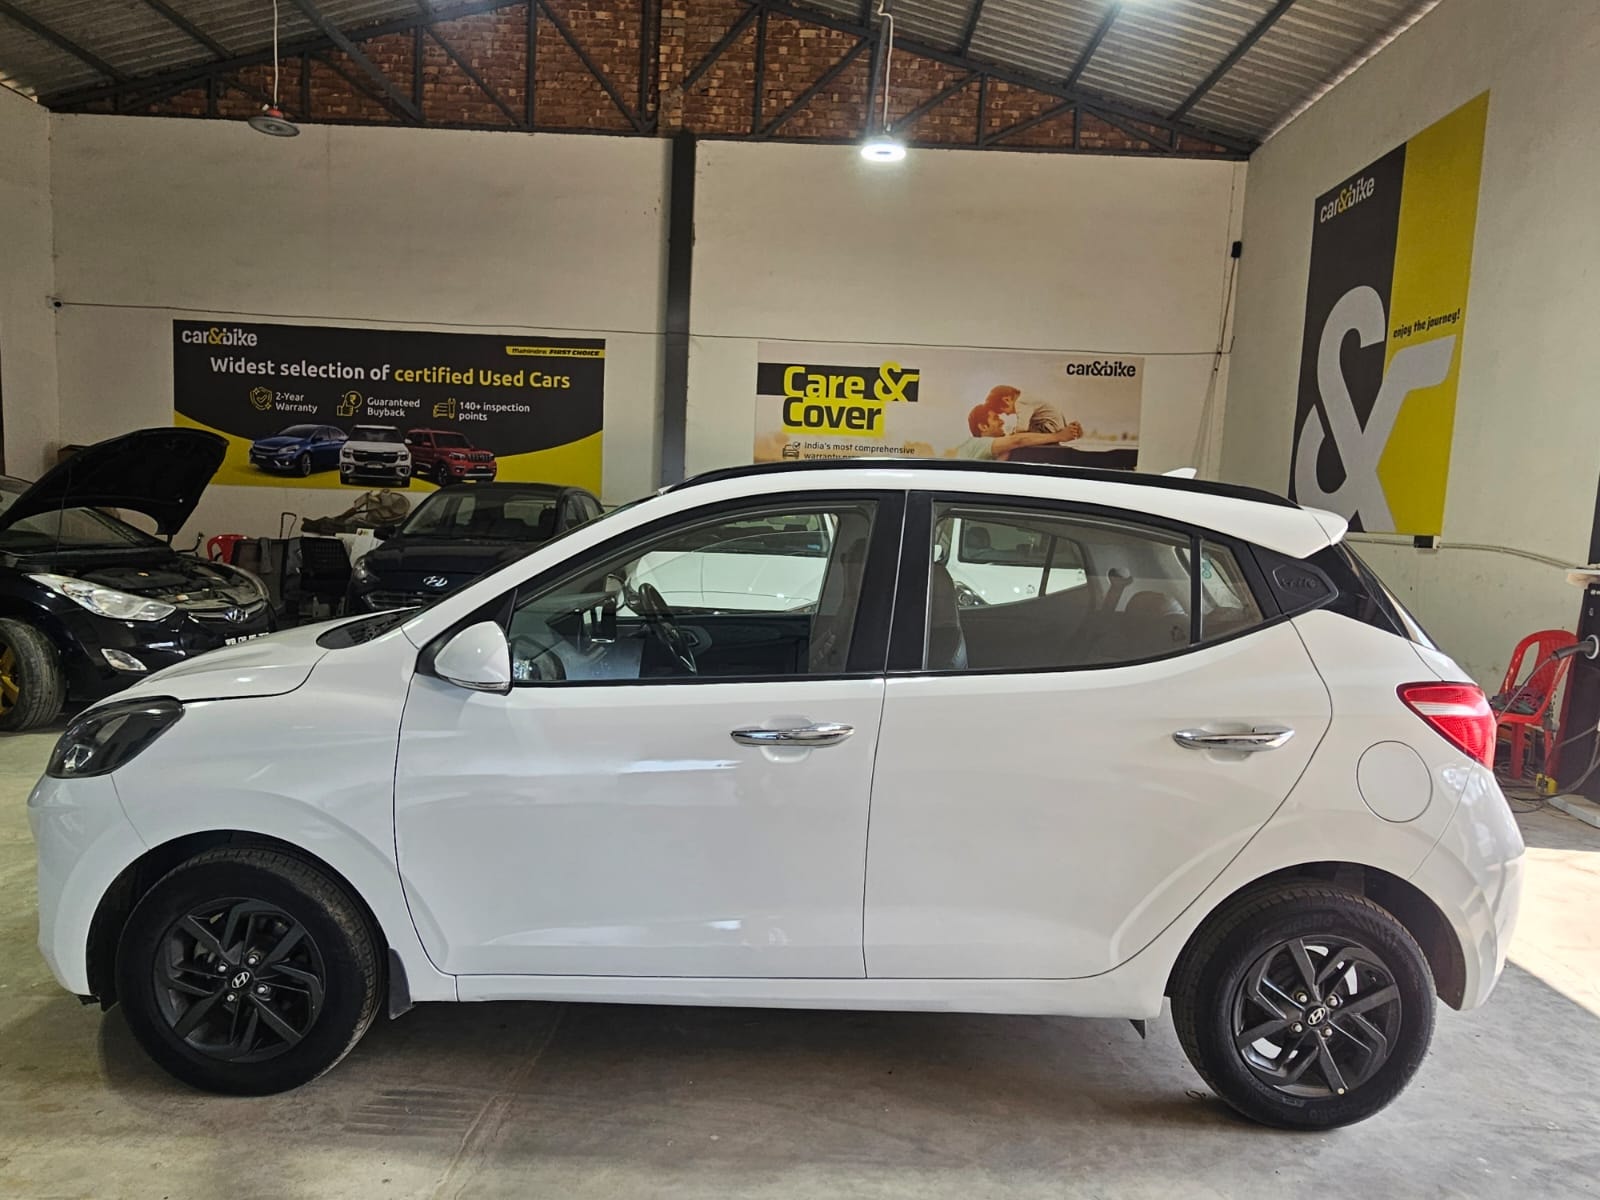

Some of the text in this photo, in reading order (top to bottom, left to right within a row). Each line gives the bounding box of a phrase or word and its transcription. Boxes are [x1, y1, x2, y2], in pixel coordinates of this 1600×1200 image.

[1320, 177, 1375, 223] car&bike
[1393, 308, 1461, 338] enjoy the journey!
[181, 327, 258, 346] car&bike
[548, 348, 571, 356] FIRST
[571, 349, 601, 357] CHOICE
[210, 356, 571, 389] Widest selection of certified Used Cars
[1066, 361, 1136, 377] car&bike
[784, 361, 920, 401] Care &
[275, 391, 305, 402] 2-Year
[367, 396, 420, 408] Guaranteed
[275, 402, 318, 414] Warranty
[367, 407, 406, 418] Buyback
[459, 401, 531, 413] 140+ inspection
[458, 411, 488, 421] points
[782, 397, 882, 431] Cover
[804, 441, 915, 454] India's most comprehensive
